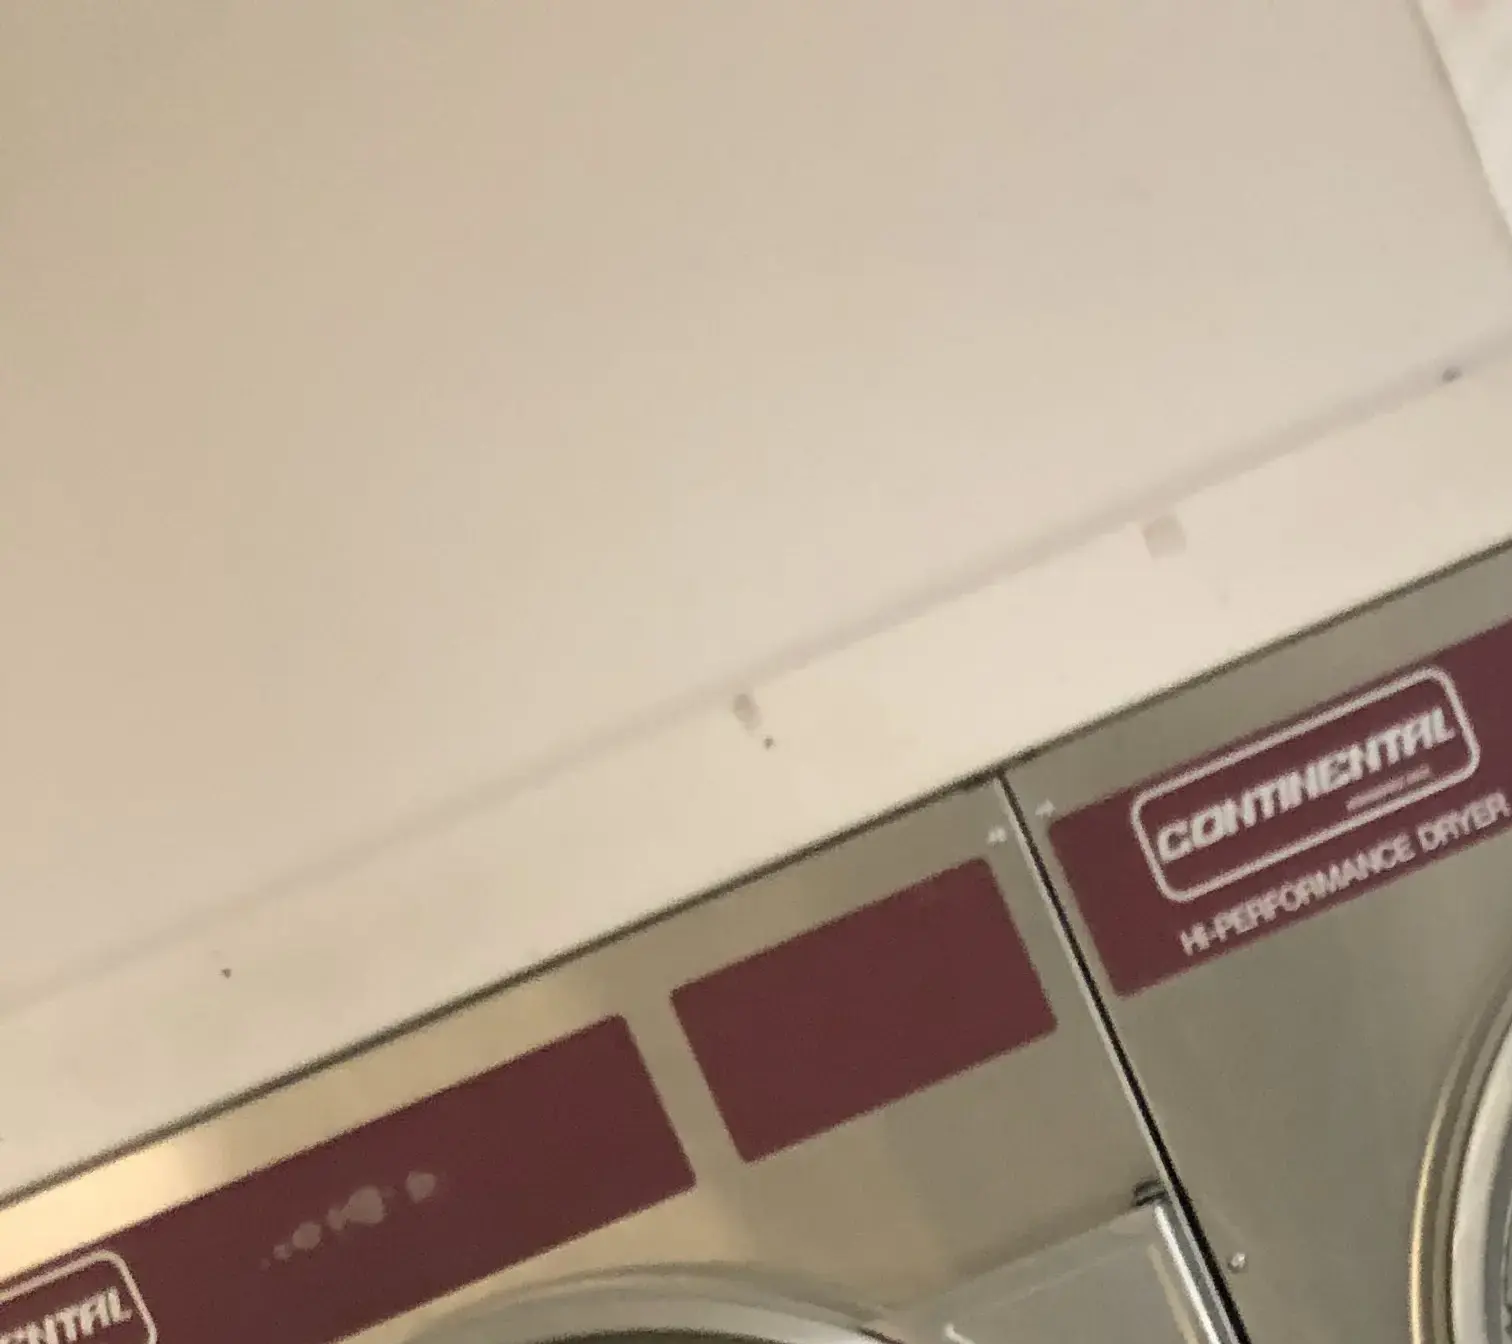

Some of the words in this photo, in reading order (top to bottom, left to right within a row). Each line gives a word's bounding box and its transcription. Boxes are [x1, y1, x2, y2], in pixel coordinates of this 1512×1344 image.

[1157, 708, 1456, 863] CONTINENTAL
[1179, 834, 1416, 956] HI-PERFORMANCE
[1417, 791, 1512, 852] DRYER
